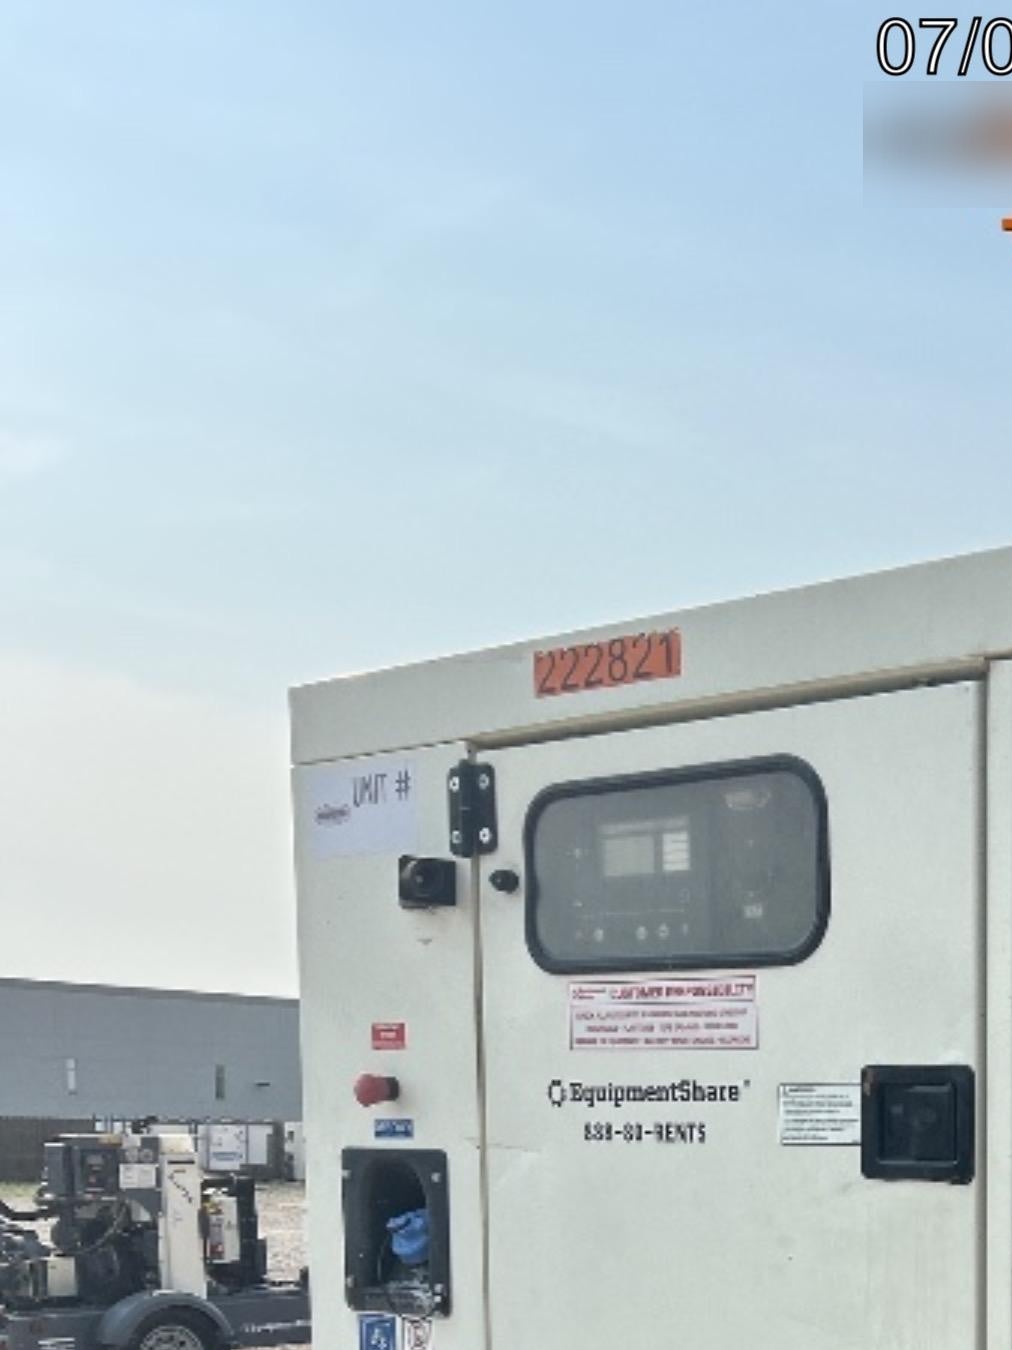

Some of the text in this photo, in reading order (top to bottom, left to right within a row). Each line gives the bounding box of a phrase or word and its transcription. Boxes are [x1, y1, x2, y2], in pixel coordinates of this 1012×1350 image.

[536, 629, 676, 695] 222821
[569, 1080, 739, 1107] EquipmentShare
[584, 1122, 706, 1143] 888-80-RENTS
